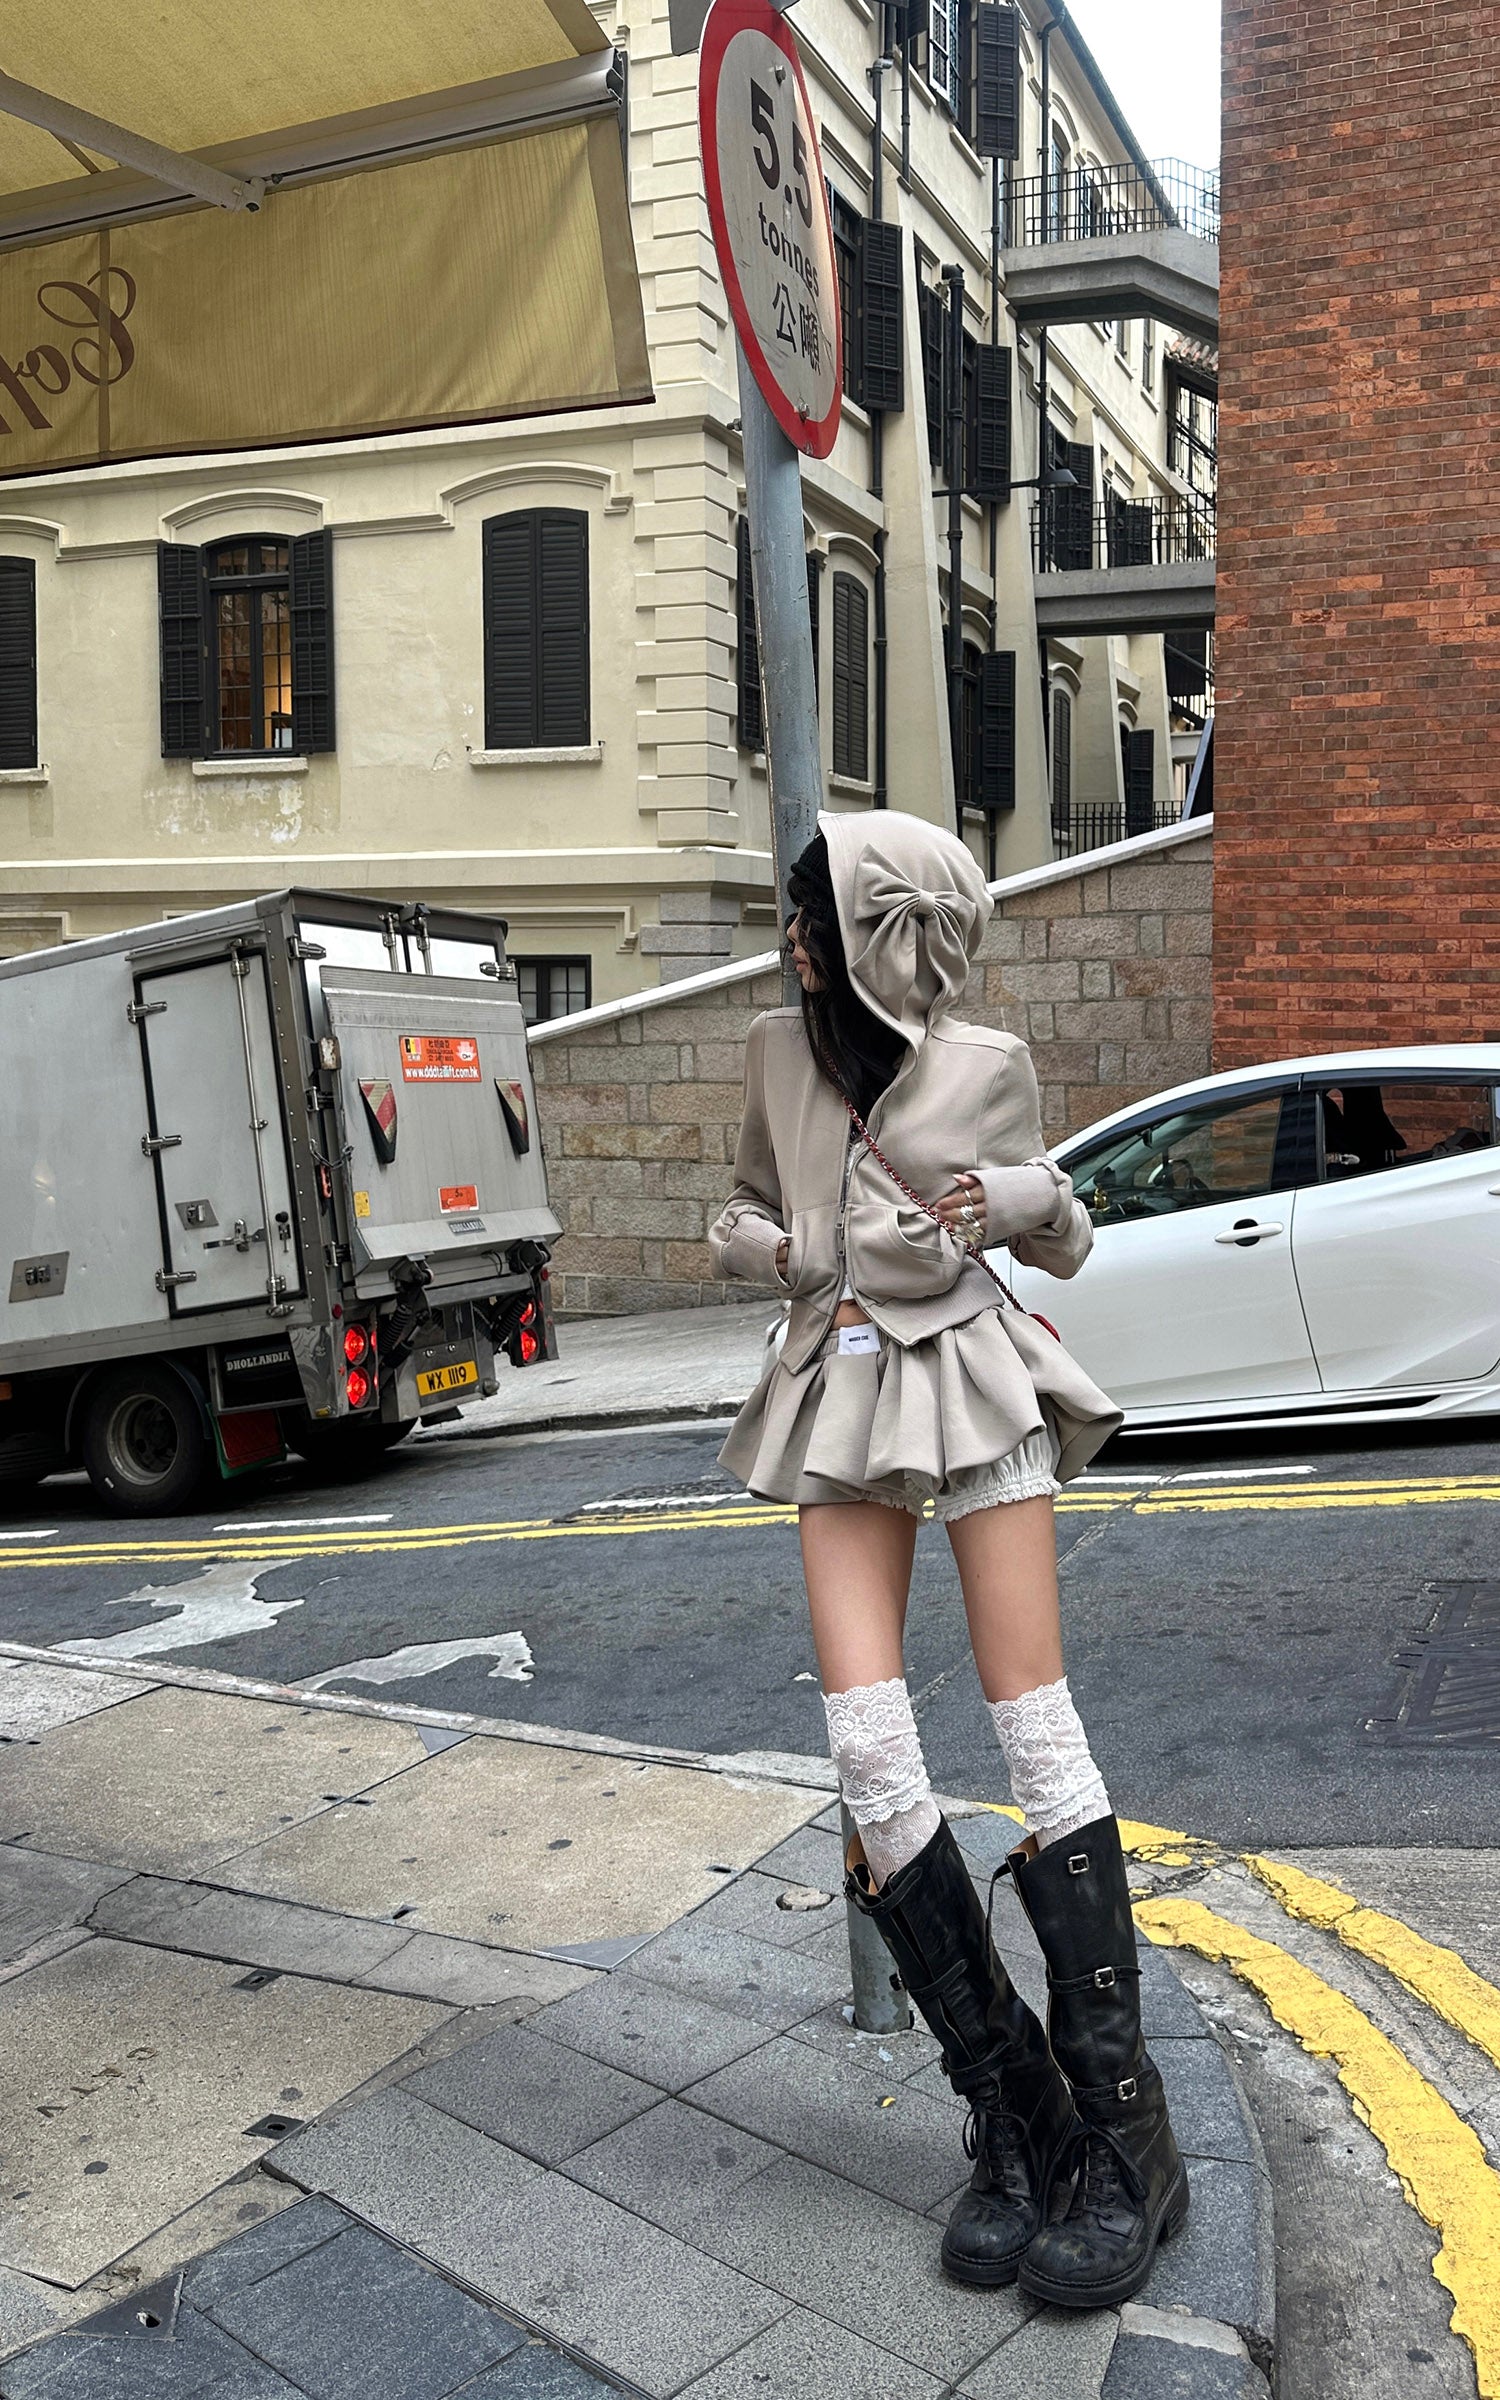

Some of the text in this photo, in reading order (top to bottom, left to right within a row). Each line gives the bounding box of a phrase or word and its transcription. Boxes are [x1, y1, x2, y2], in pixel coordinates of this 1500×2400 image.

[751, 77, 813, 229] 5.5
[758, 201, 820, 298] tonnes
[226, 1350, 291, 1372] DHOLLANDIA
[426, 1365, 467, 1391] WX 1119
